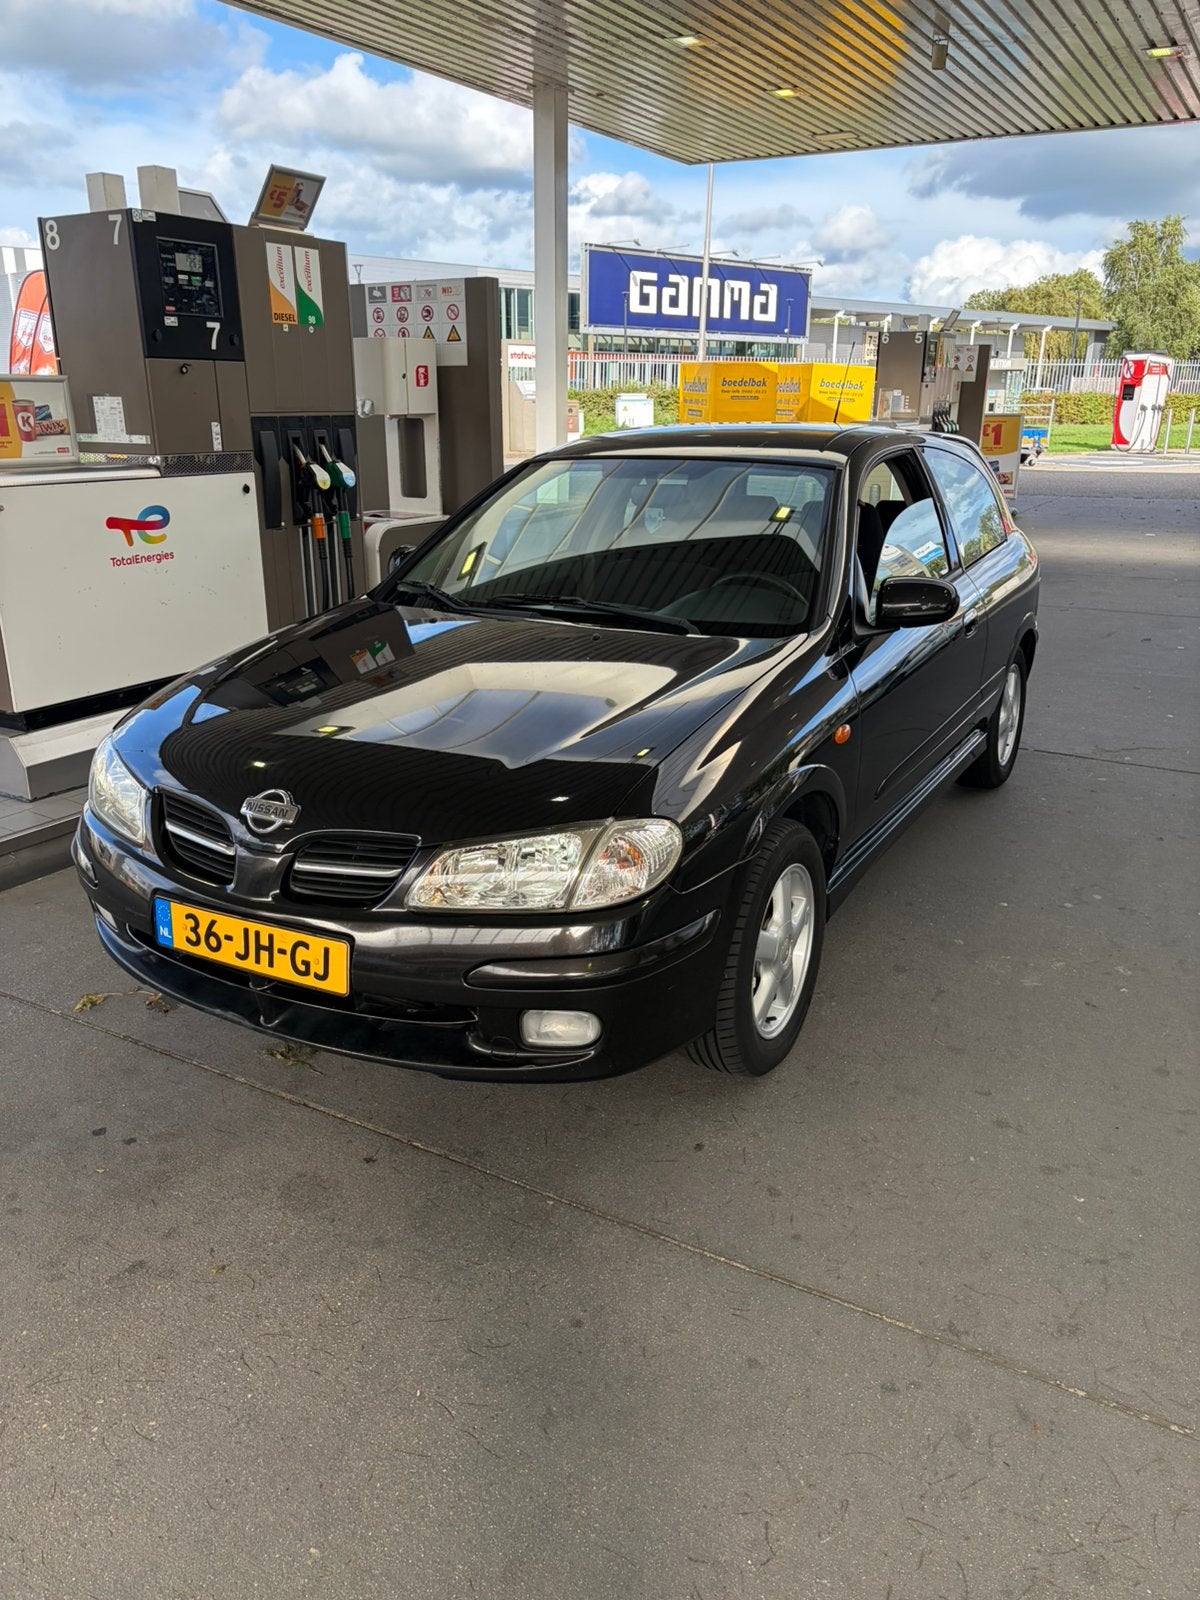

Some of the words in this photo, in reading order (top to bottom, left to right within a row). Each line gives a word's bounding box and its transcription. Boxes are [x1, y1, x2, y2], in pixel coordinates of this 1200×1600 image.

[45, 219, 60, 250] 8
[108, 214, 122, 245] 7
[276, 246, 286, 289] excellium
[304, 250, 313, 293] excellium
[273, 312, 296, 322] DIESEL
[206, 321, 220, 350] 7
[882, 332, 890, 344] 6
[914, 332, 923, 344] 5
[721, 377, 767, 387] boedelbak
[820, 378, 864, 390] boedelbak
[21, 415, 33, 428] K
[110, 551, 175, 567] TotalEnergies
[246, 802, 288, 817] NISSAN
[159, 925, 172, 939] NL
[184, 913, 330, 982] 36-JH-GJ
